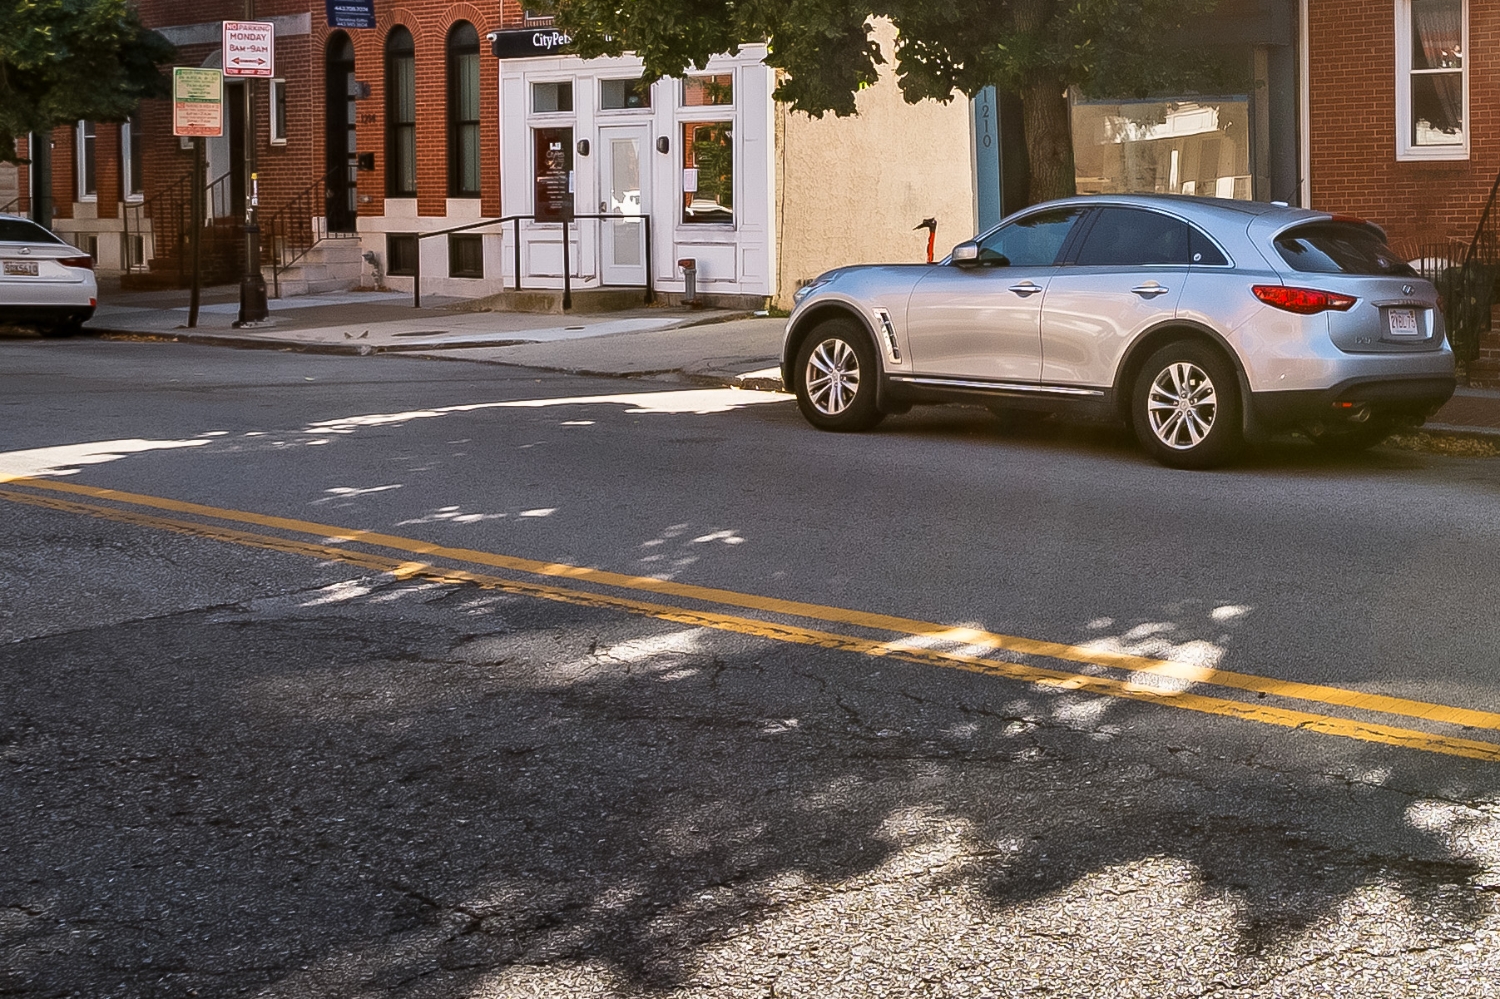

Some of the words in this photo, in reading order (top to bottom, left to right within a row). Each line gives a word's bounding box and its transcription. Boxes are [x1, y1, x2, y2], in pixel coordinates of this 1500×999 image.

[239, 24, 270, 32] PARKING
[230, 32, 267, 41] MONDAY
[982, 89, 992, 148] 1210
